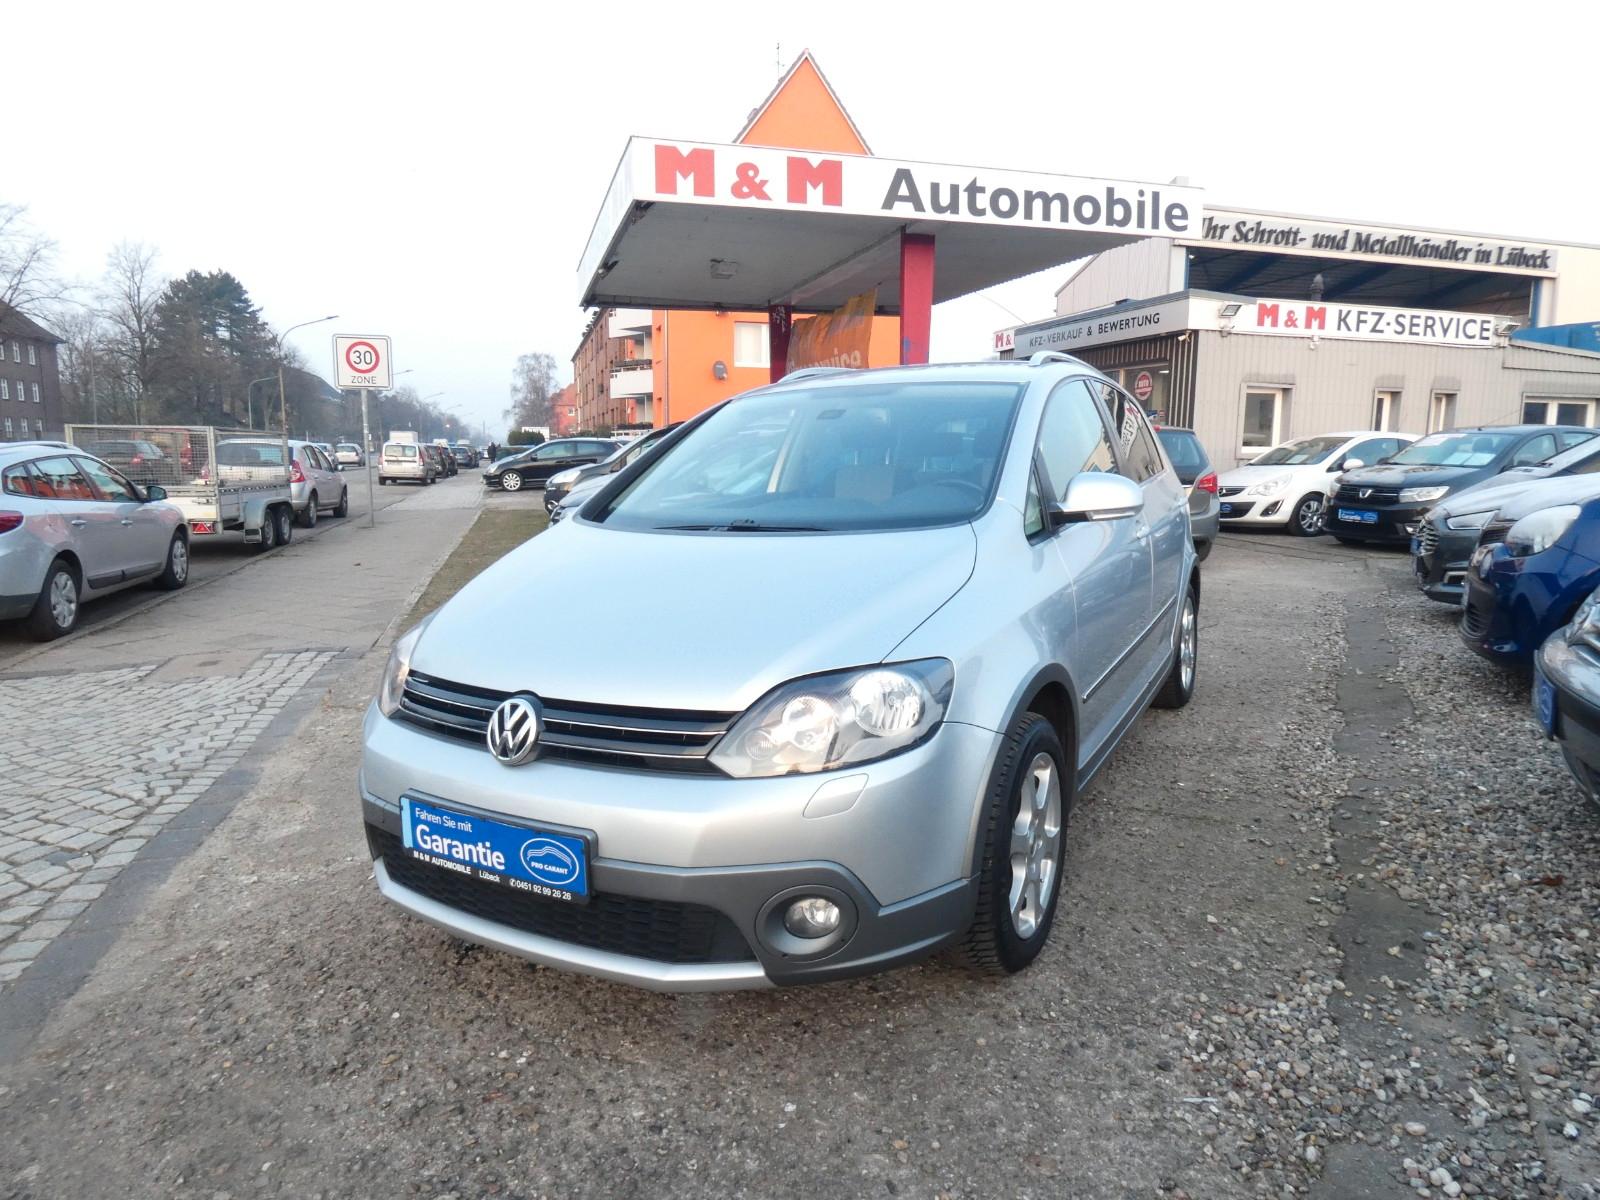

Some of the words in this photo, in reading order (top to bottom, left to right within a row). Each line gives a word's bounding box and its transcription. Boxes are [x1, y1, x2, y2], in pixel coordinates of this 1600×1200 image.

[654, 144, 715, 197] M
[731, 162, 773, 201] &
[787, 156, 842, 207] M
[881, 168, 1189, 231] Automobile
[1232, 220, 1306, 246] Schrott-
[1311, 229, 1350, 250] und
[1352, 232, 1472, 261] Metallhändler
[1474, 243, 1492, 263] in
[1496, 246, 1551, 269] Lübeck
[1087, 326, 1093, 336] &
[1098, 312, 1160, 334] BEWERTUNG
[1257, 303, 1279, 327] M
[1284, 310, 1298, 328] &
[1304, 306, 1326, 330] M
[353, 350, 373, 365] 30
[351, 375, 377, 385] ZONE
[415, 807, 442, 825] Fahren
[442, 816, 456, 829] Sie
[457, 821, 472, 833] mit
[416, 824, 505, 870] Garantie
[431, 856, 472, 874] AUTOMOBILE
[479, 870, 500, 883] Lübeck
[533, 884, 542, 894] 92
[530, 861, 543, 870] PRO
[544, 864, 568, 875] GARANT
